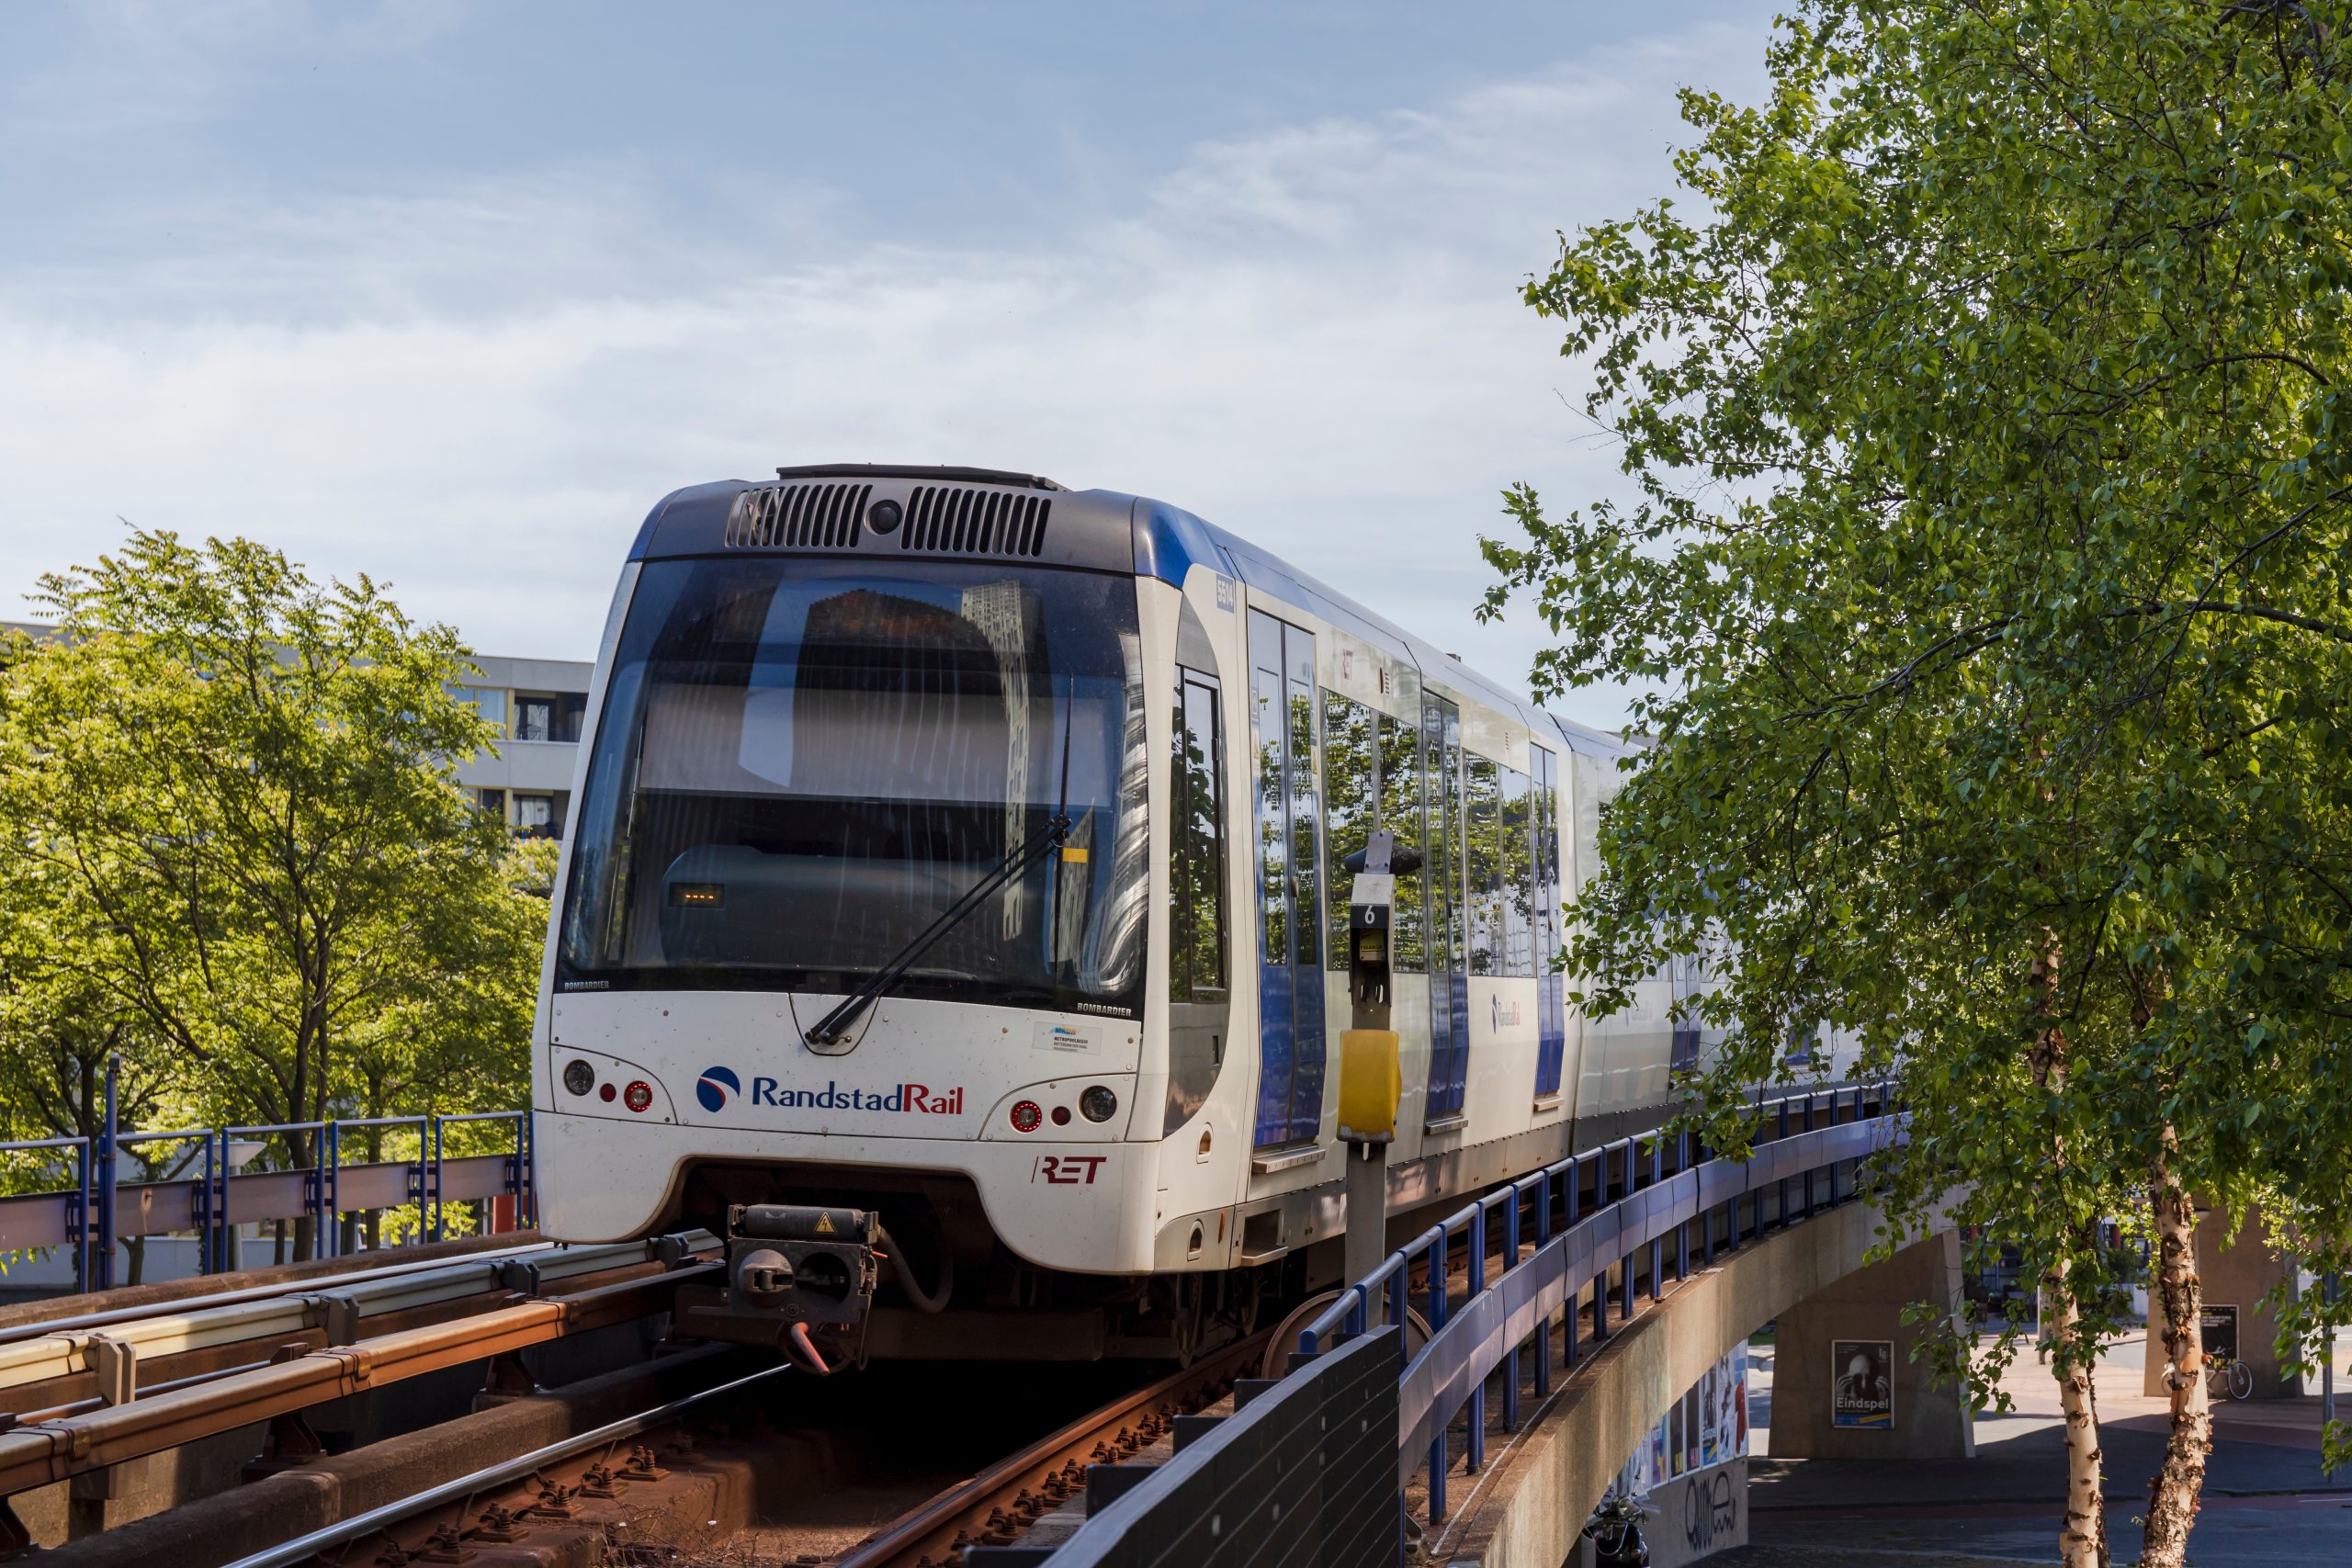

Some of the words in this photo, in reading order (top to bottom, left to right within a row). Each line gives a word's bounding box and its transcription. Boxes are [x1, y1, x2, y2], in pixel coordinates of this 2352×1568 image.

[1217, 579, 1234, 607] 5514
[1364, 905, 1375, 924] 6
[564, 980, 609, 990] BOMBARDIER
[1077, 1002, 1132, 1017] BOMBARDIER
[752, 1076, 964, 1115] RandstadRail
[1031, 1156, 1107, 1184] RET
[1837, 1397, 1889, 1411] Eindspel
